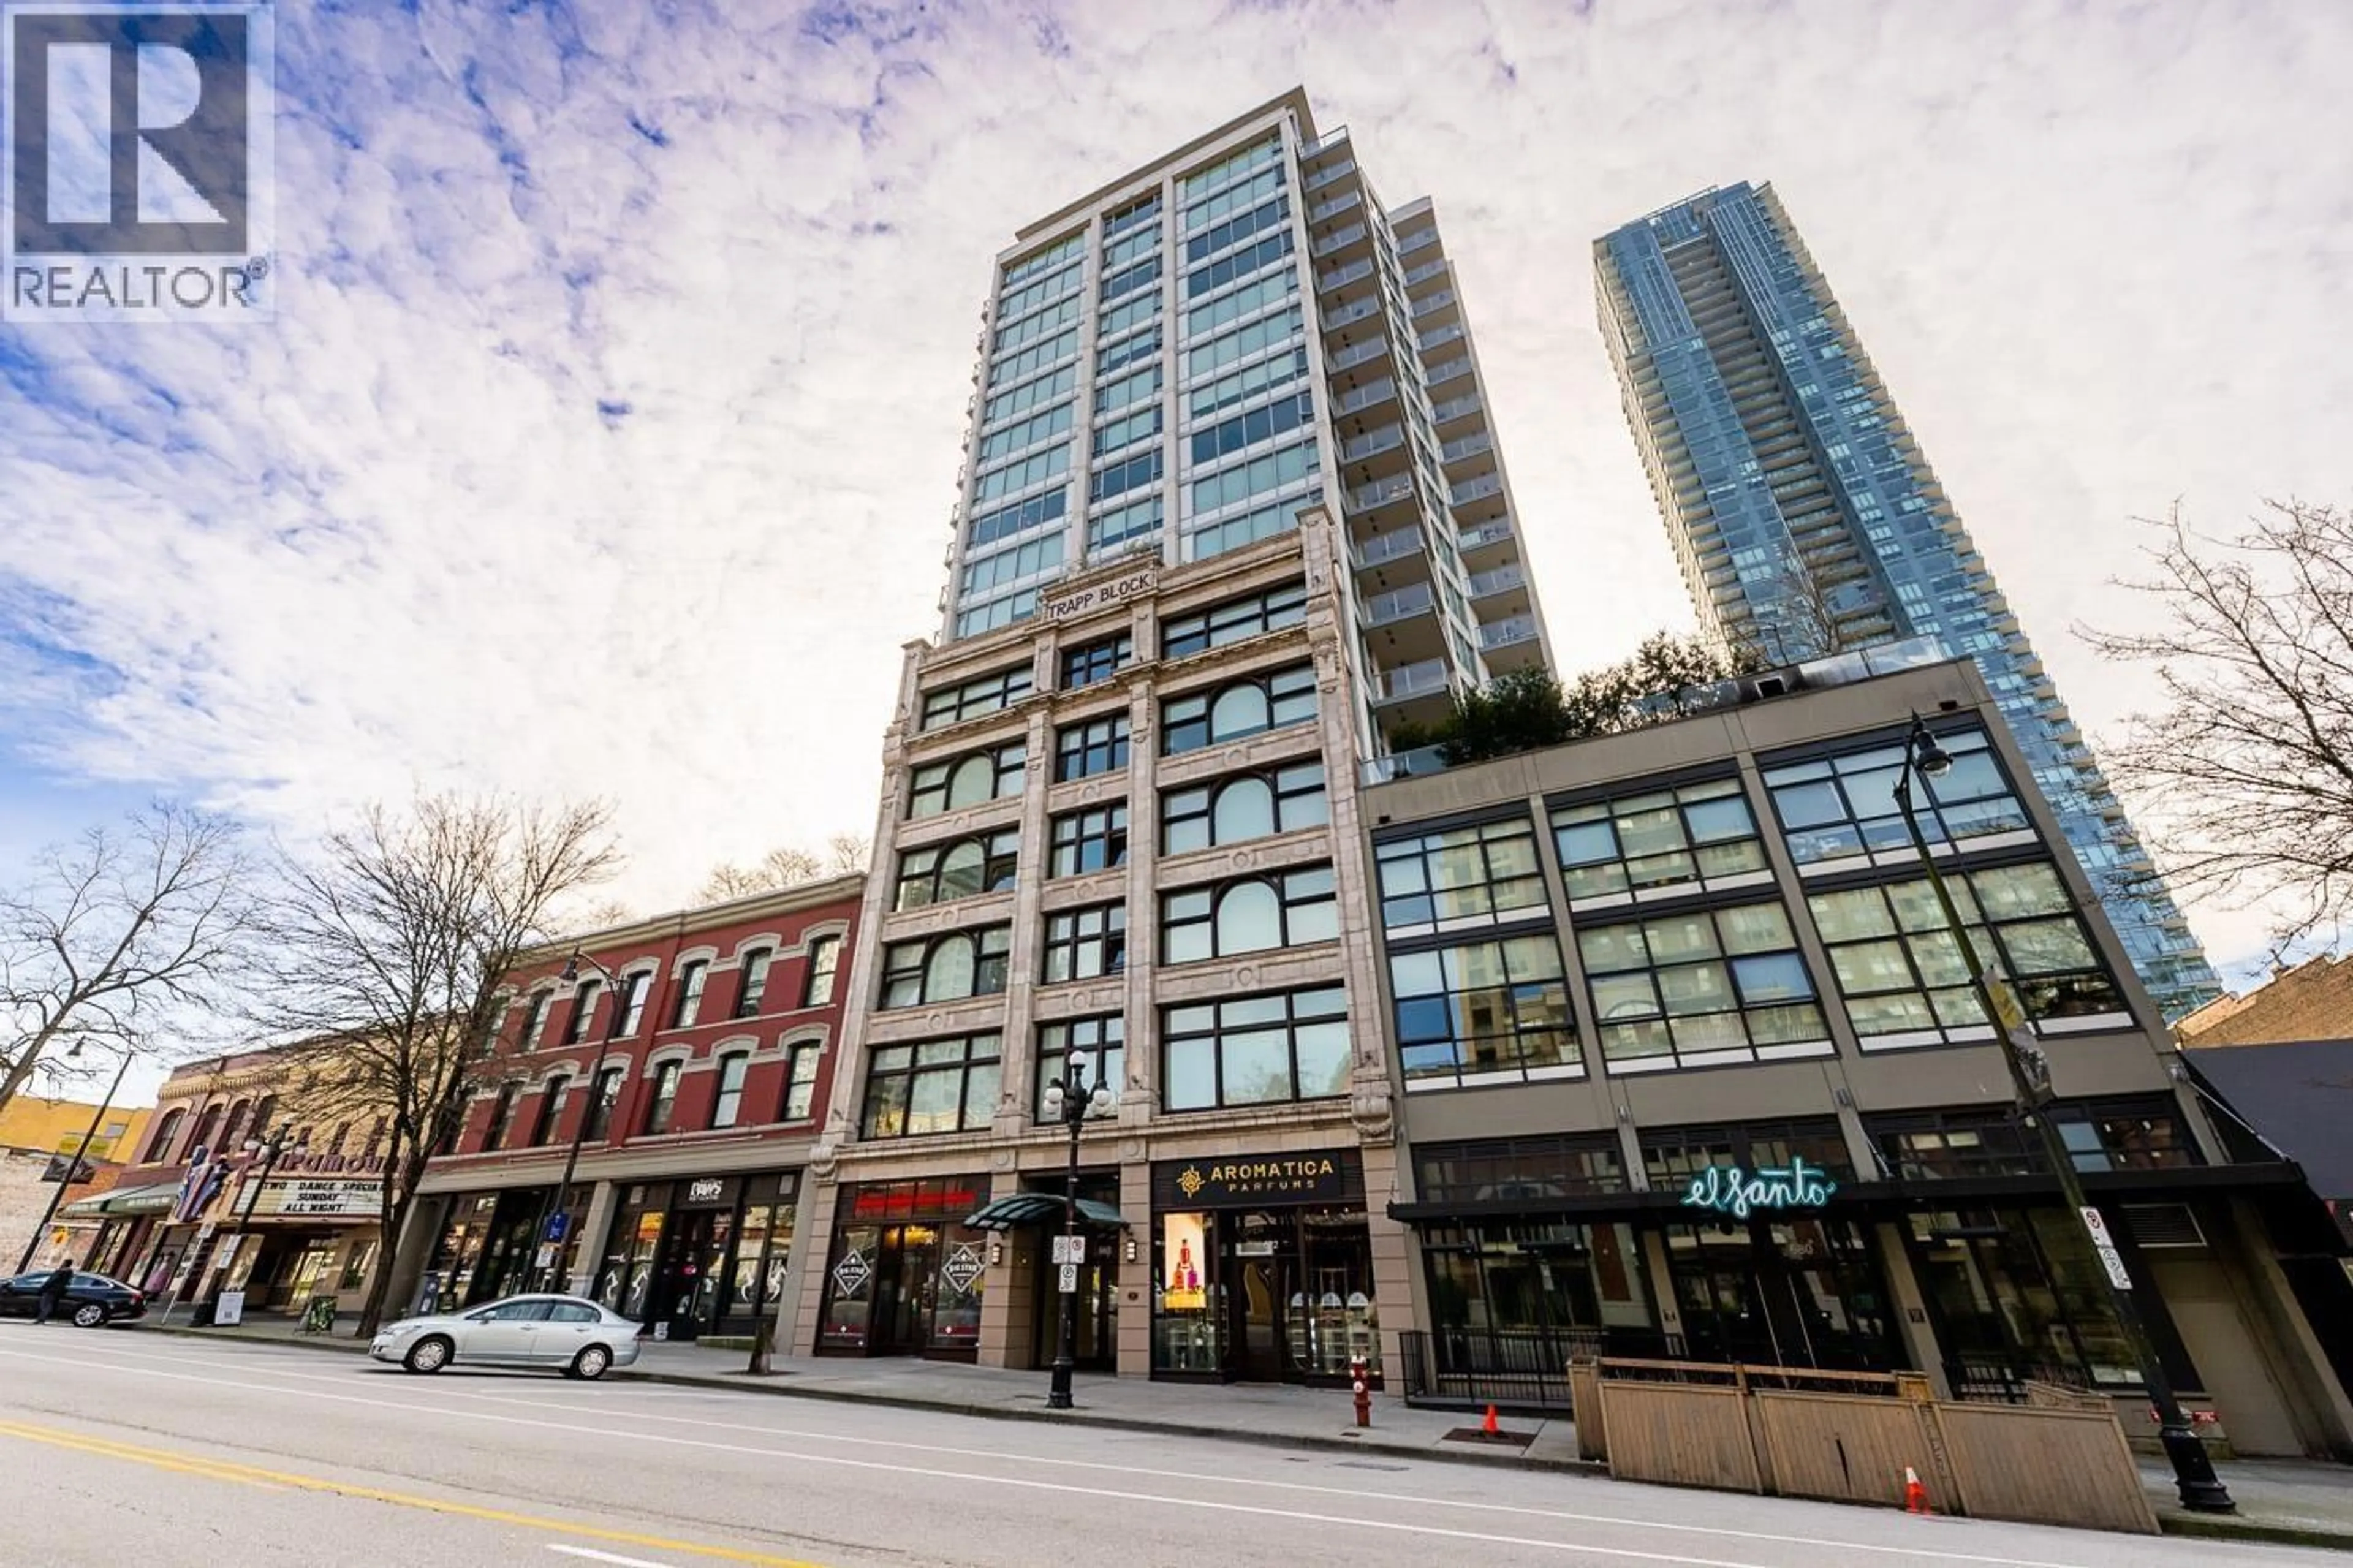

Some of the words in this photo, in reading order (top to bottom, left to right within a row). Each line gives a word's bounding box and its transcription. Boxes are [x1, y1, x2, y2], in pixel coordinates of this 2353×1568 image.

[1048, 593, 1093, 618] TRAPP
[1099, 574, 1150, 602] BLOCK
[1211, 1159, 1334, 1181] AROMATICA
[1229, 1180, 1316, 1192] PARFUMS
[1682, 1166, 1725, 1212] el
[297, 1192, 341, 1201] SUNDAY
[283, 1203, 305, 1212] ALL
[309, 1203, 344, 1212] NIGHT
